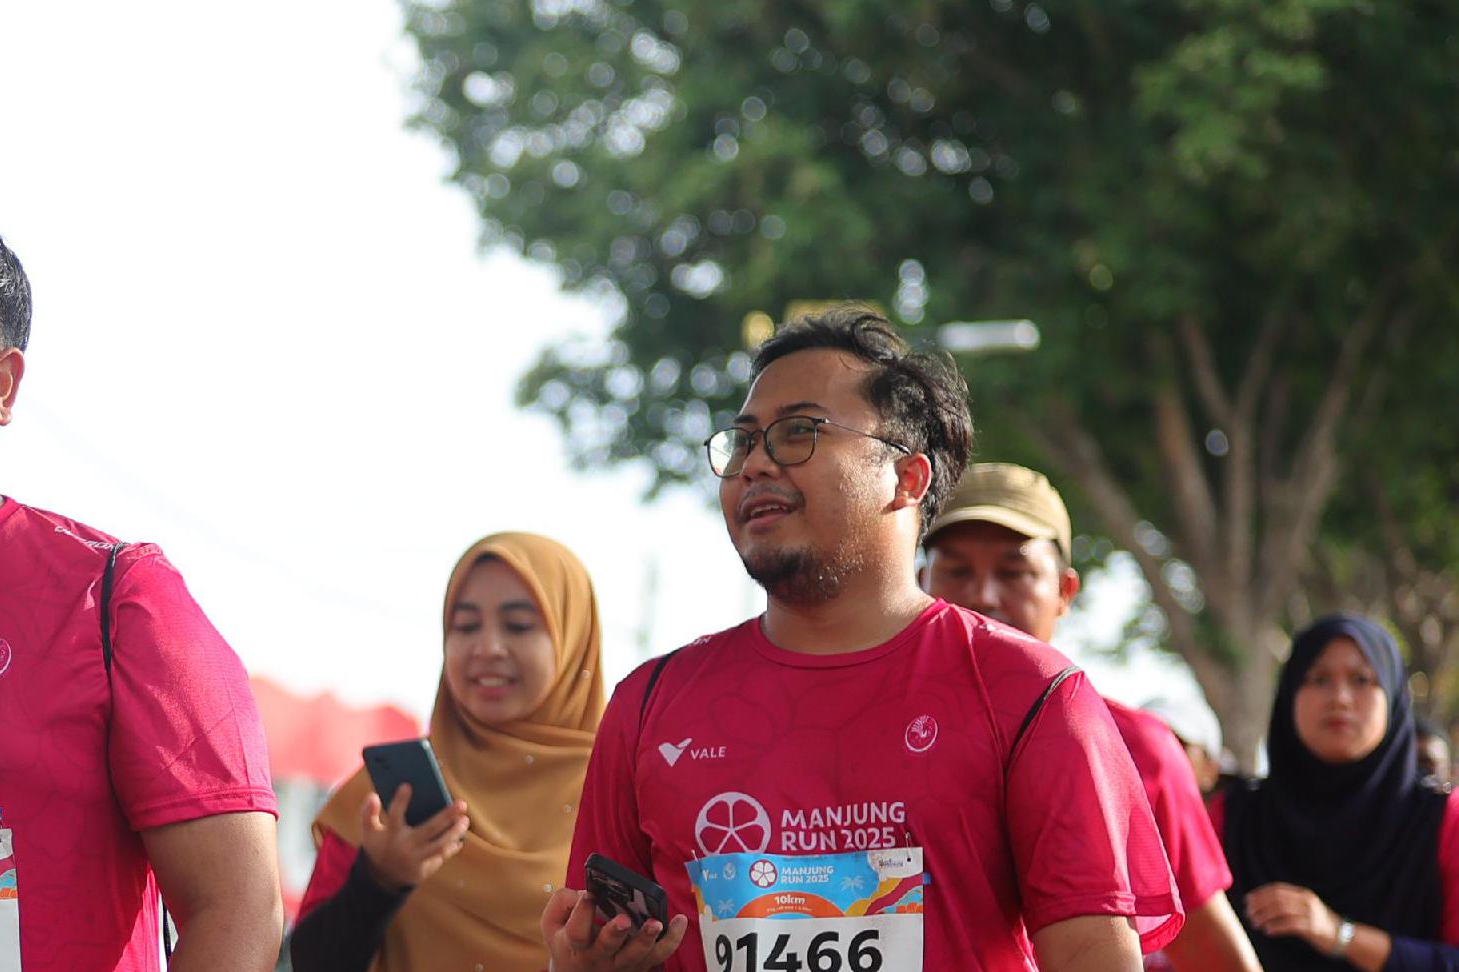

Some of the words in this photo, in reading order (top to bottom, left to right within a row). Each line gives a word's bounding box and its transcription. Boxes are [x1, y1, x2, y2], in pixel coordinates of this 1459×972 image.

[691, 746, 726, 760] VALE
[781, 802, 905, 829] MANJUNG
[781, 830, 837, 851] RUN
[841, 827, 896, 849] 2025
[782, 865, 834, 875] MANJUNG
[782, 875, 804, 884] RUN
[805, 874, 830, 883] 2025
[774, 894, 806, 905] 10km
